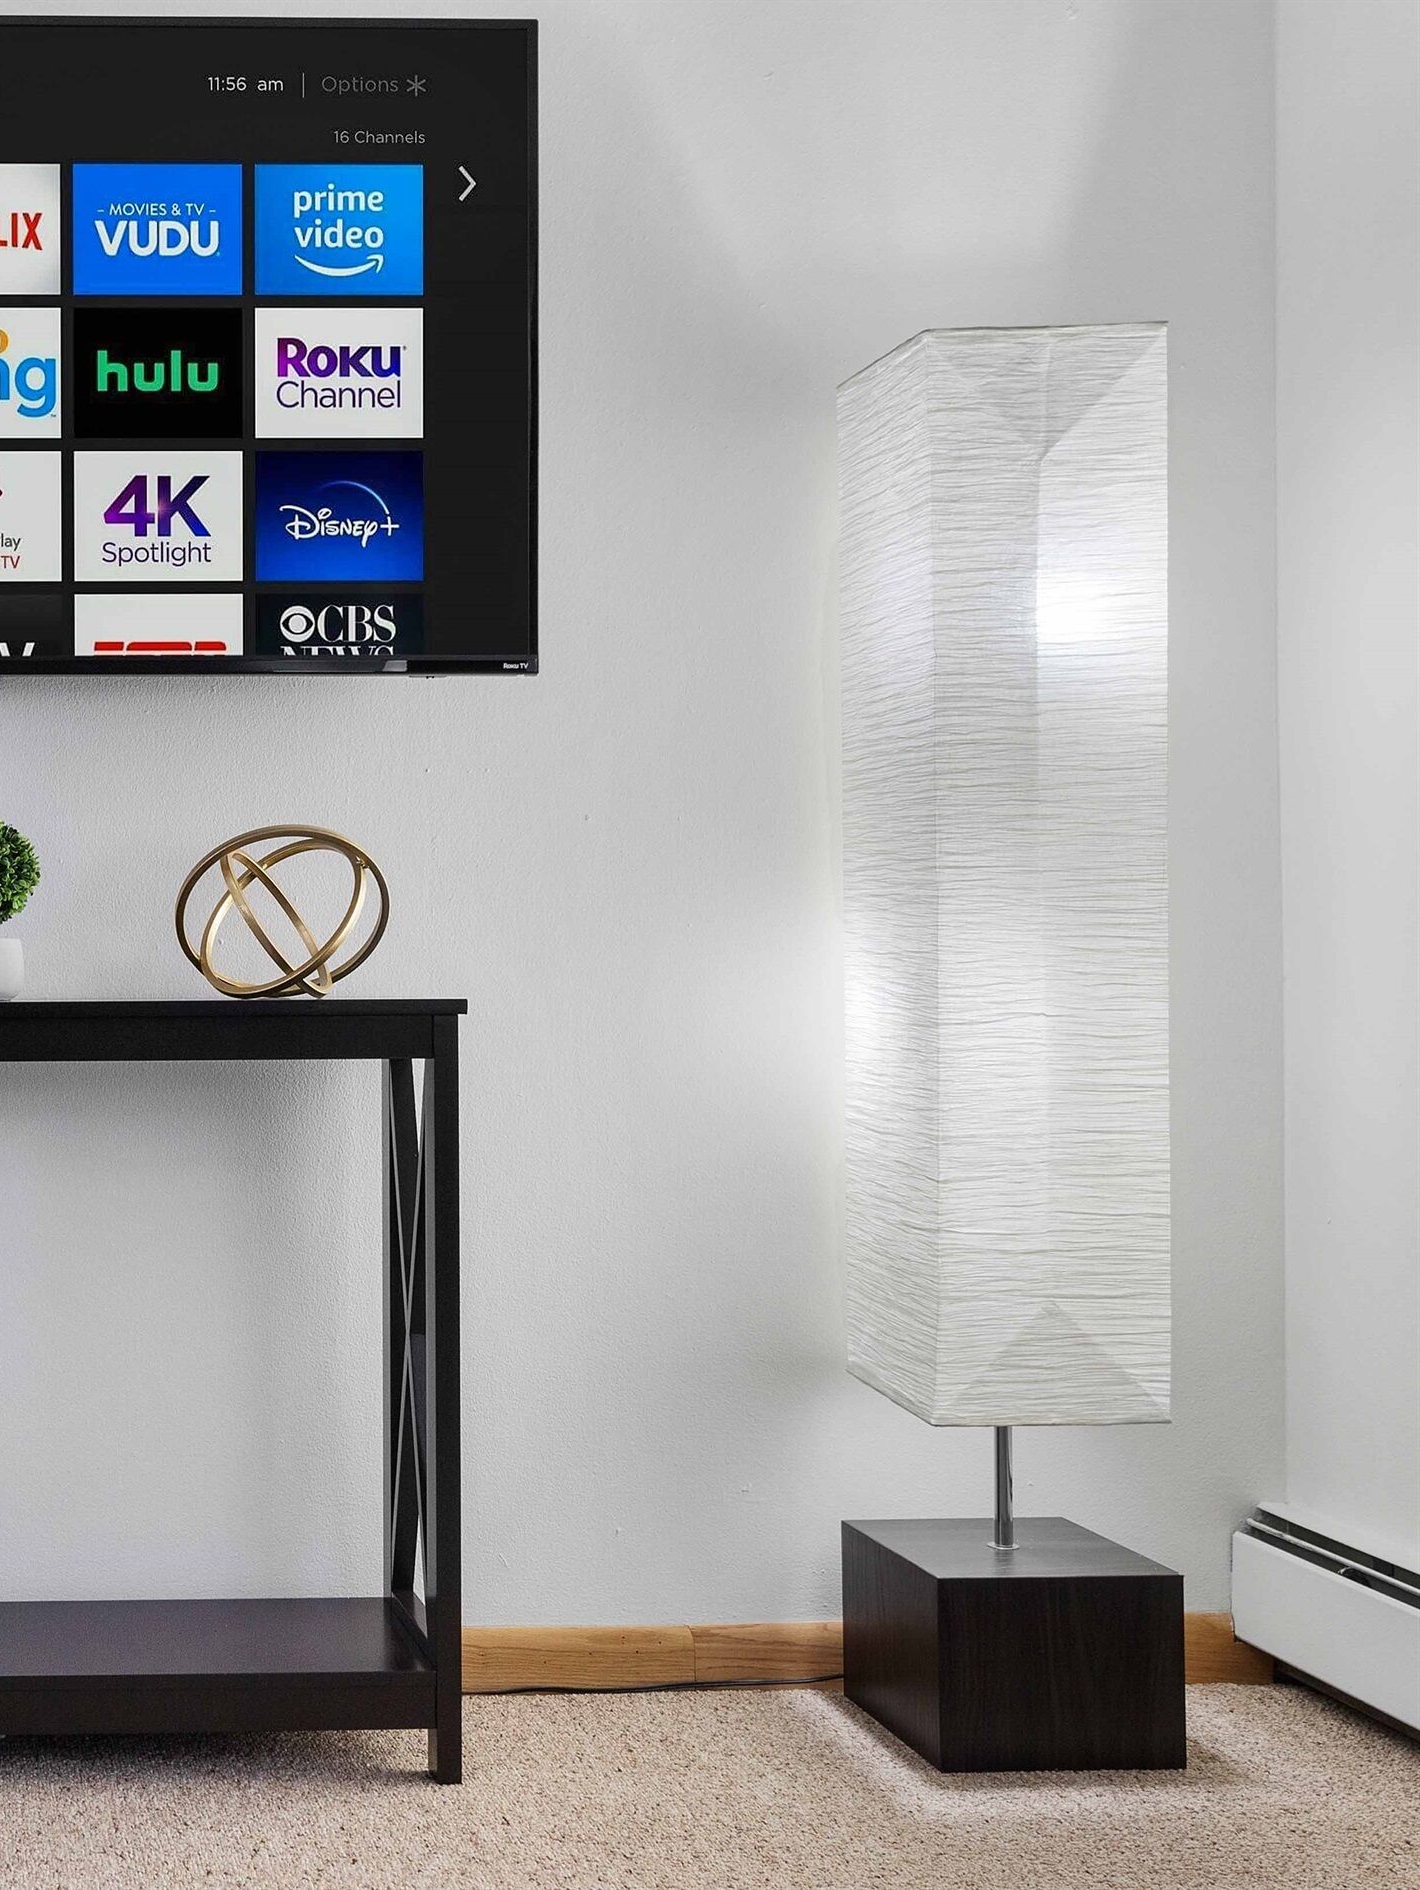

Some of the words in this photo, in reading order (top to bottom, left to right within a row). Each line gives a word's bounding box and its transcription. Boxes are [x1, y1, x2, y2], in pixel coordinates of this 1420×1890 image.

[208, 76, 247, 92] 11:56
[257, 79, 284, 92] am
[321, 75, 399, 95] Options
[333, 129, 350, 144] 16
[354, 129, 426, 145] Channels
[109, 202, 167, 217] MOVIES
[171, 203, 182, 217] &
[186, 202, 205, 216] TV
[293, 183, 384, 218] prime
[94, 220, 219, 257] VUDU
[294, 219, 384, 249] video
[96, 350, 219, 392] hulu
[276, 338, 400, 378] Roku
[276, 380, 401, 409] Channel
[103, 475, 212, 537] 4K
[1, 556, 21, 569] TV
[102, 541, 212, 567] Spotlight
[317, 604, 397, 643] CBS
